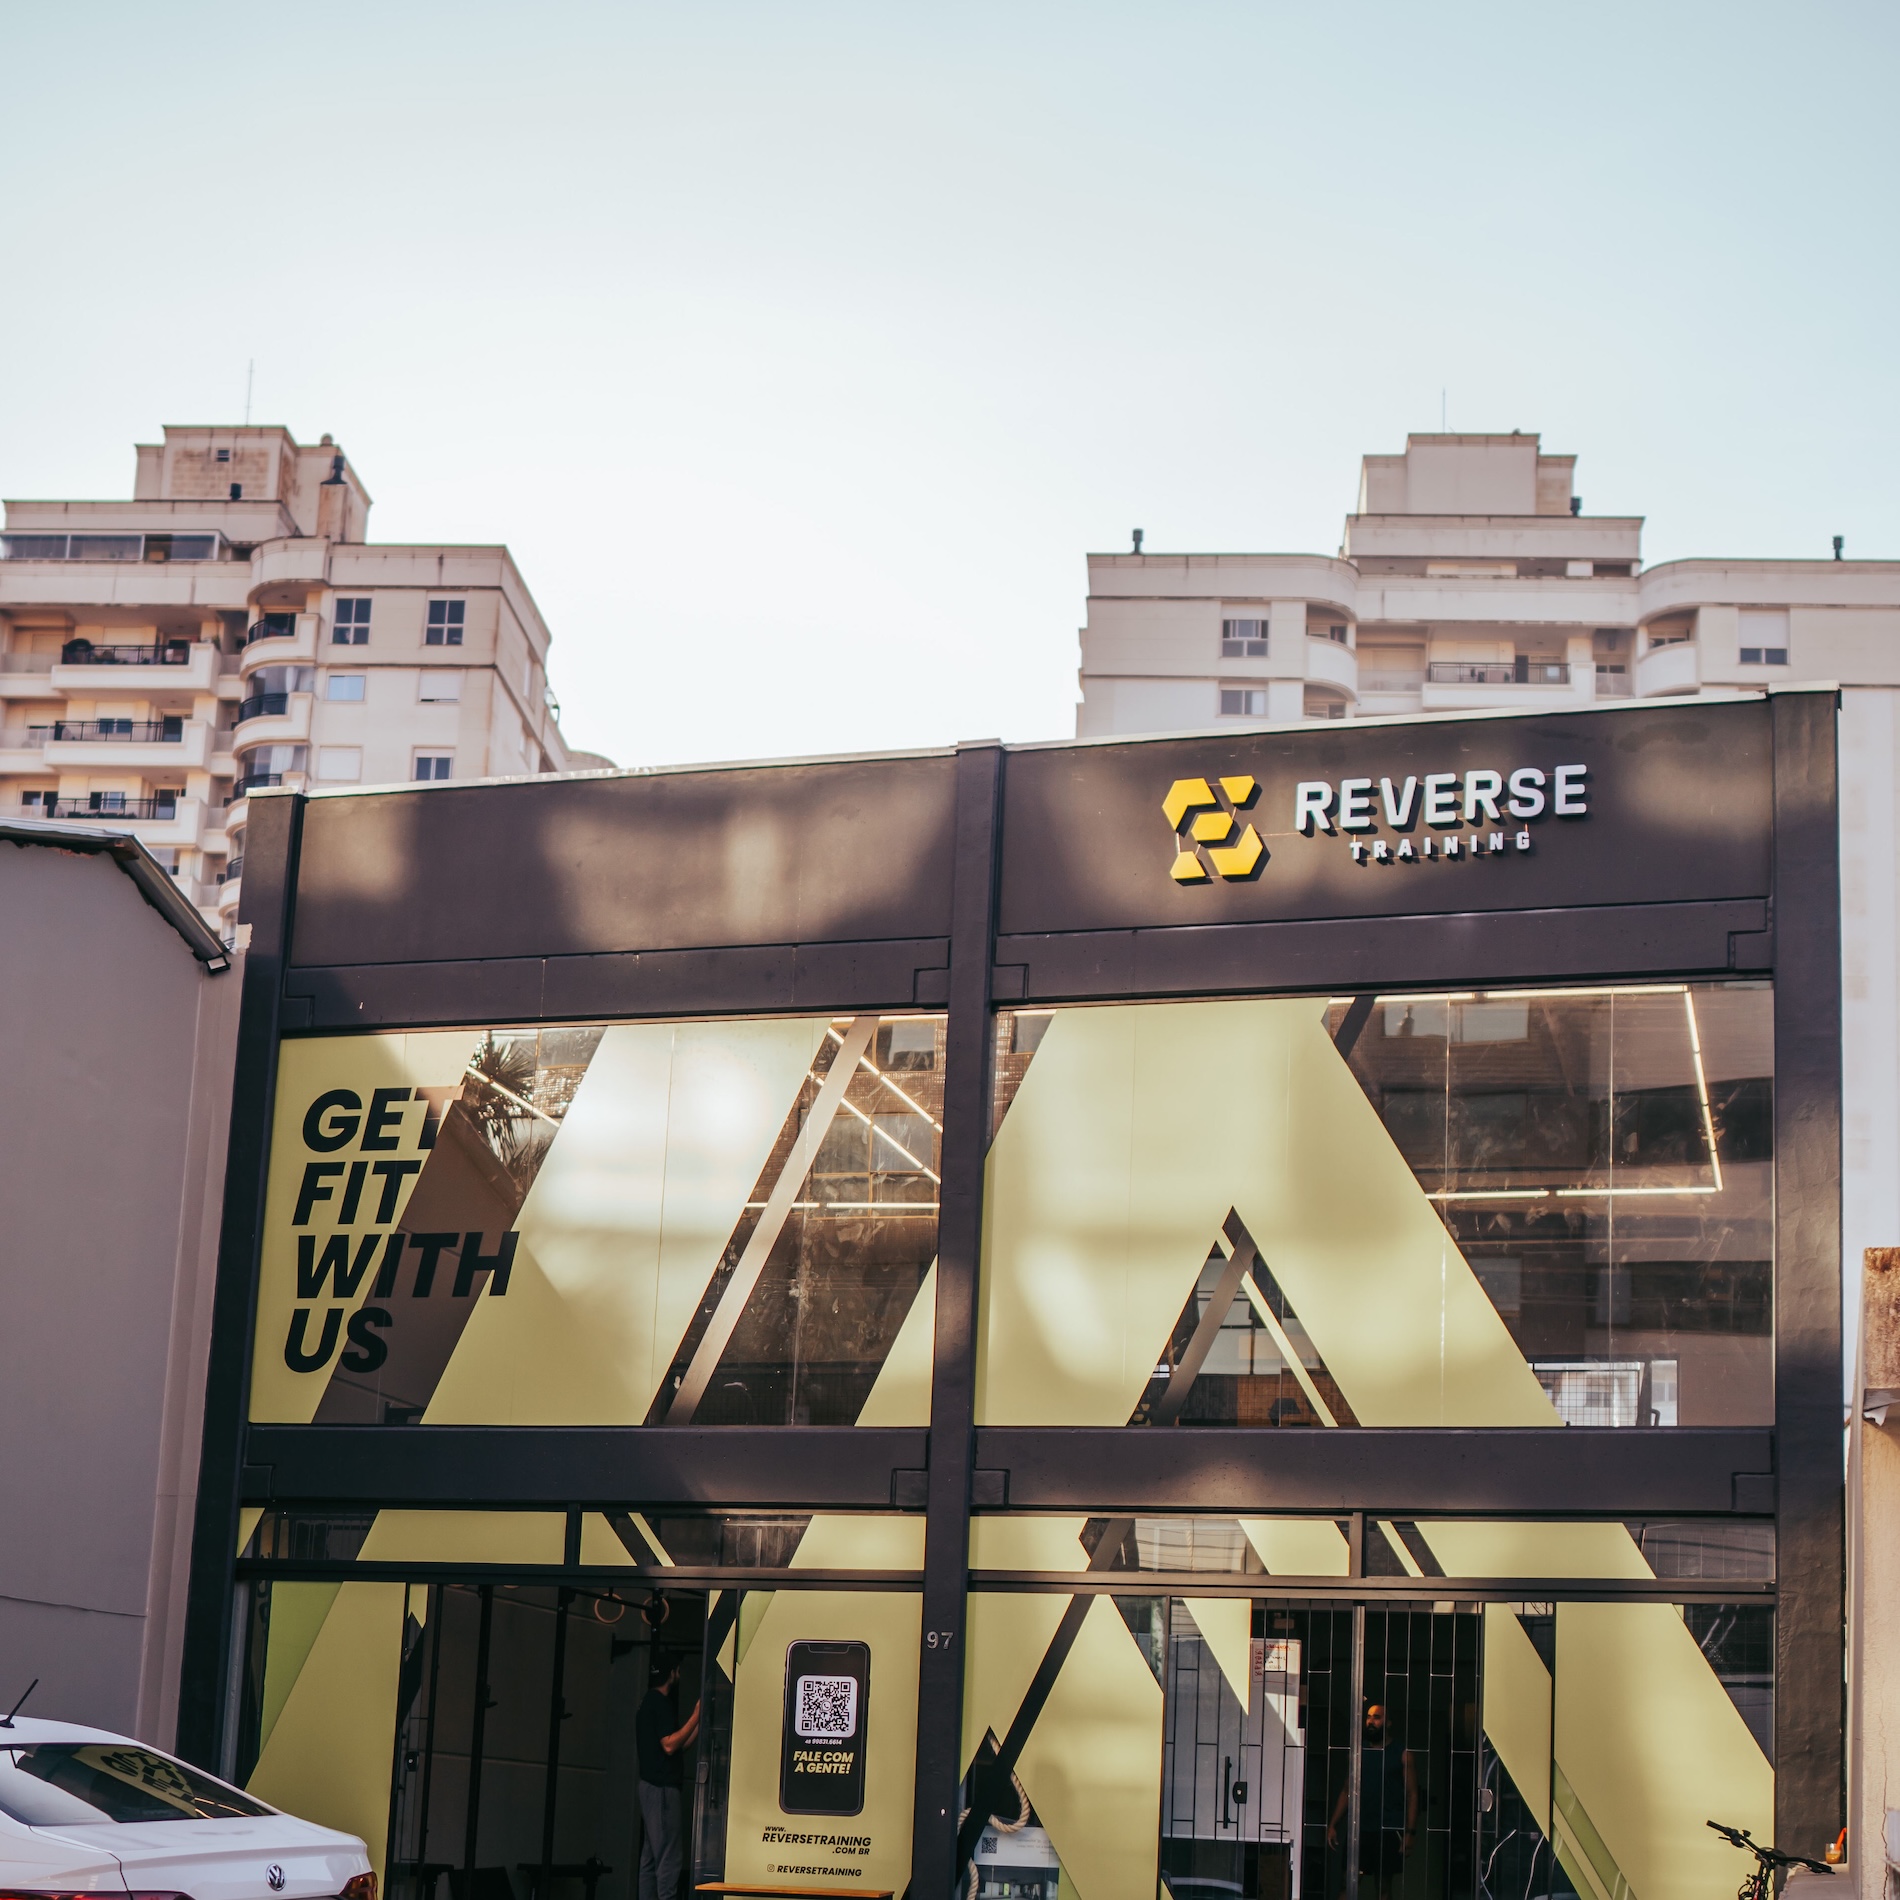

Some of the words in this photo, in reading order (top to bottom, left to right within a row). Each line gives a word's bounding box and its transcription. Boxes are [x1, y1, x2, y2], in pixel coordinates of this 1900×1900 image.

[1295, 764, 1587, 831] REVERSE
[1349, 831, 1531, 860] TRAINING
[302, 1085, 466, 1153] GET
[291, 1160, 423, 1226] FIT
[297, 1231, 521, 1299] WITH
[284, 1307, 393, 1374] US
[926, 1631, 954, 1650] 97
[793, 1750, 822, 1762] FALE
[823, 1751, 854, 1763] COM
[794, 1762, 804, 1773] A
[806, 1763, 851, 1774] GENTE!
[762, 1833, 872, 1847] REVERSETRAINING
[777, 1865, 862, 1877] REVERSETRAINING
